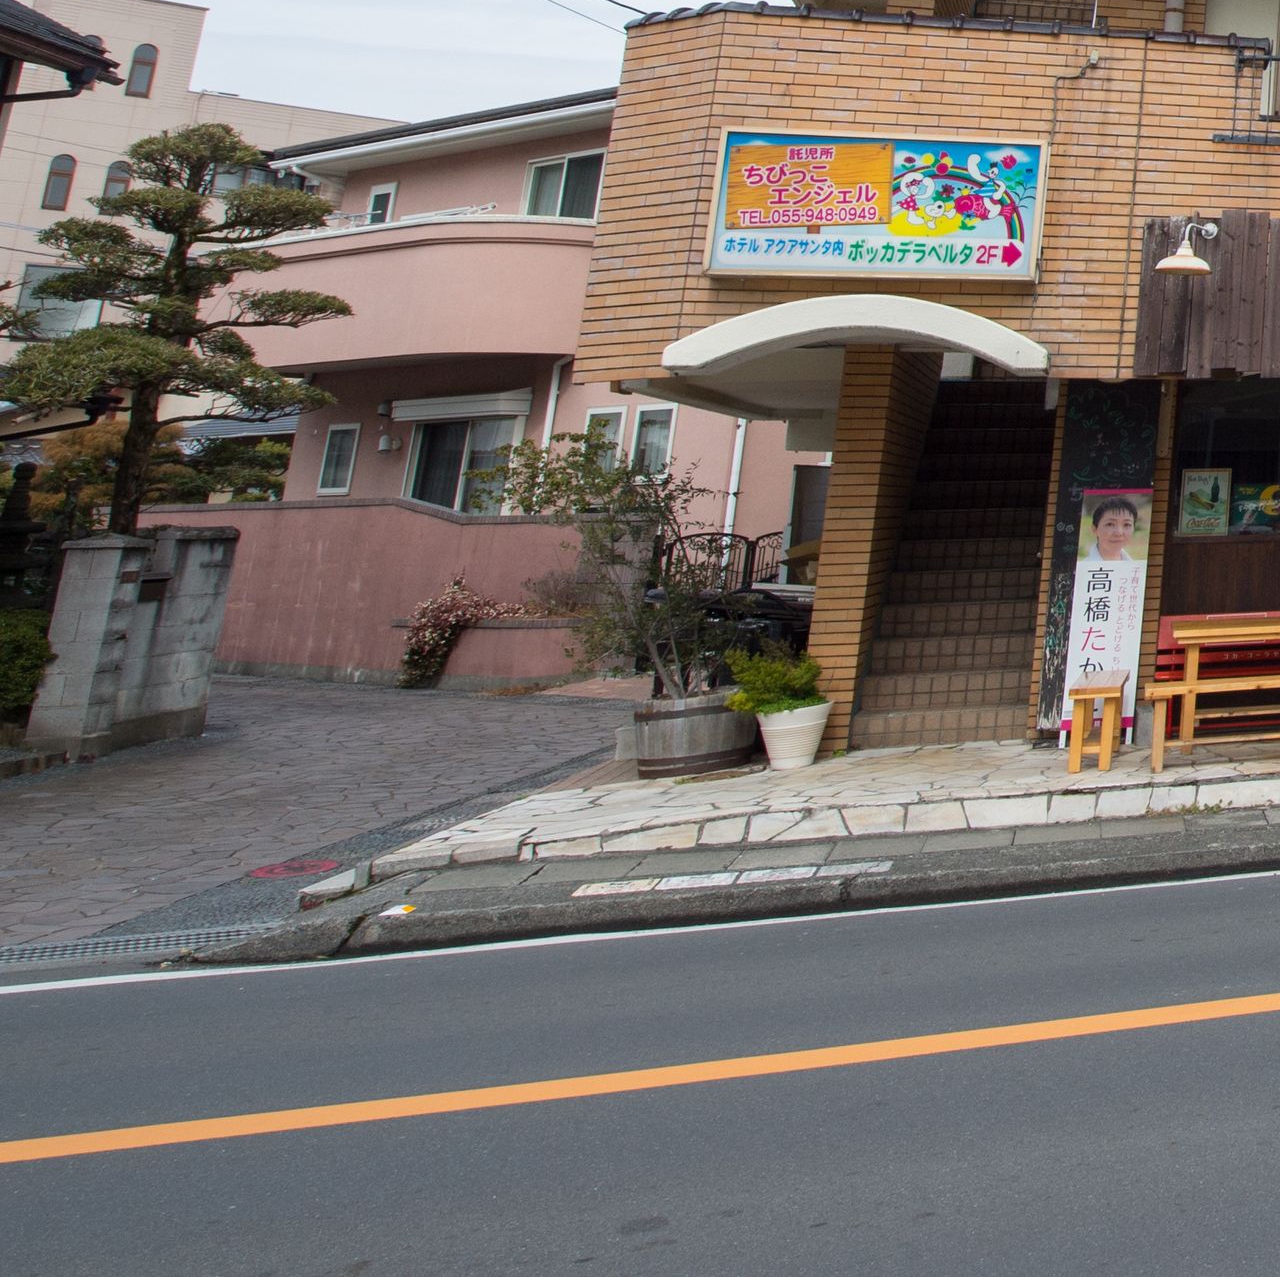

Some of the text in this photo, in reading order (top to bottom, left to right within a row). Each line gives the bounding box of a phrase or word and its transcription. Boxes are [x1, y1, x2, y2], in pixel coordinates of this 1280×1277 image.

[788, 147, 834, 161] 託児所
[743, 164, 829, 186] ちびっこ
[769, 183, 877, 206] エンジェル
[739, 206, 878, 226] TEL.055-948-0949
[724, 237, 1000, 265] ホテル アクアサンタ内 ボッカデラベルタ 2F
[1078, 566, 1114, 675] 高橋たか
